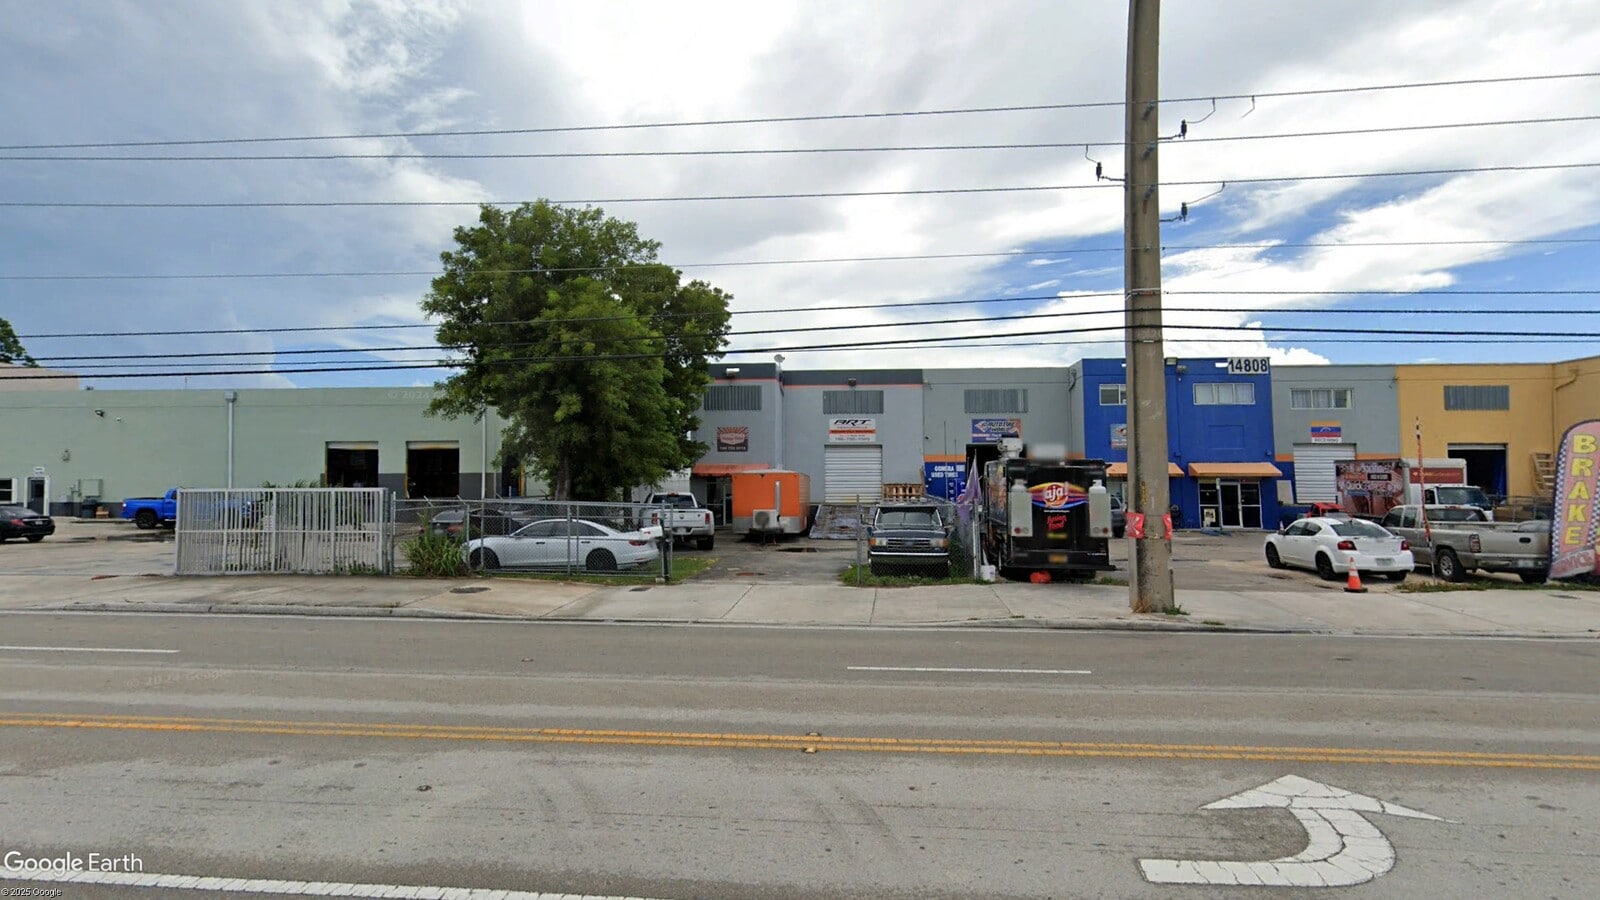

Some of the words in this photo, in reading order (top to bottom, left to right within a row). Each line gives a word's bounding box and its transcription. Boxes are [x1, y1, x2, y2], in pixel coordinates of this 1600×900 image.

[1229, 359, 1268, 372] 14808
[834, 419, 871, 427] ART
[1564, 434, 1598, 545] BRAKE
